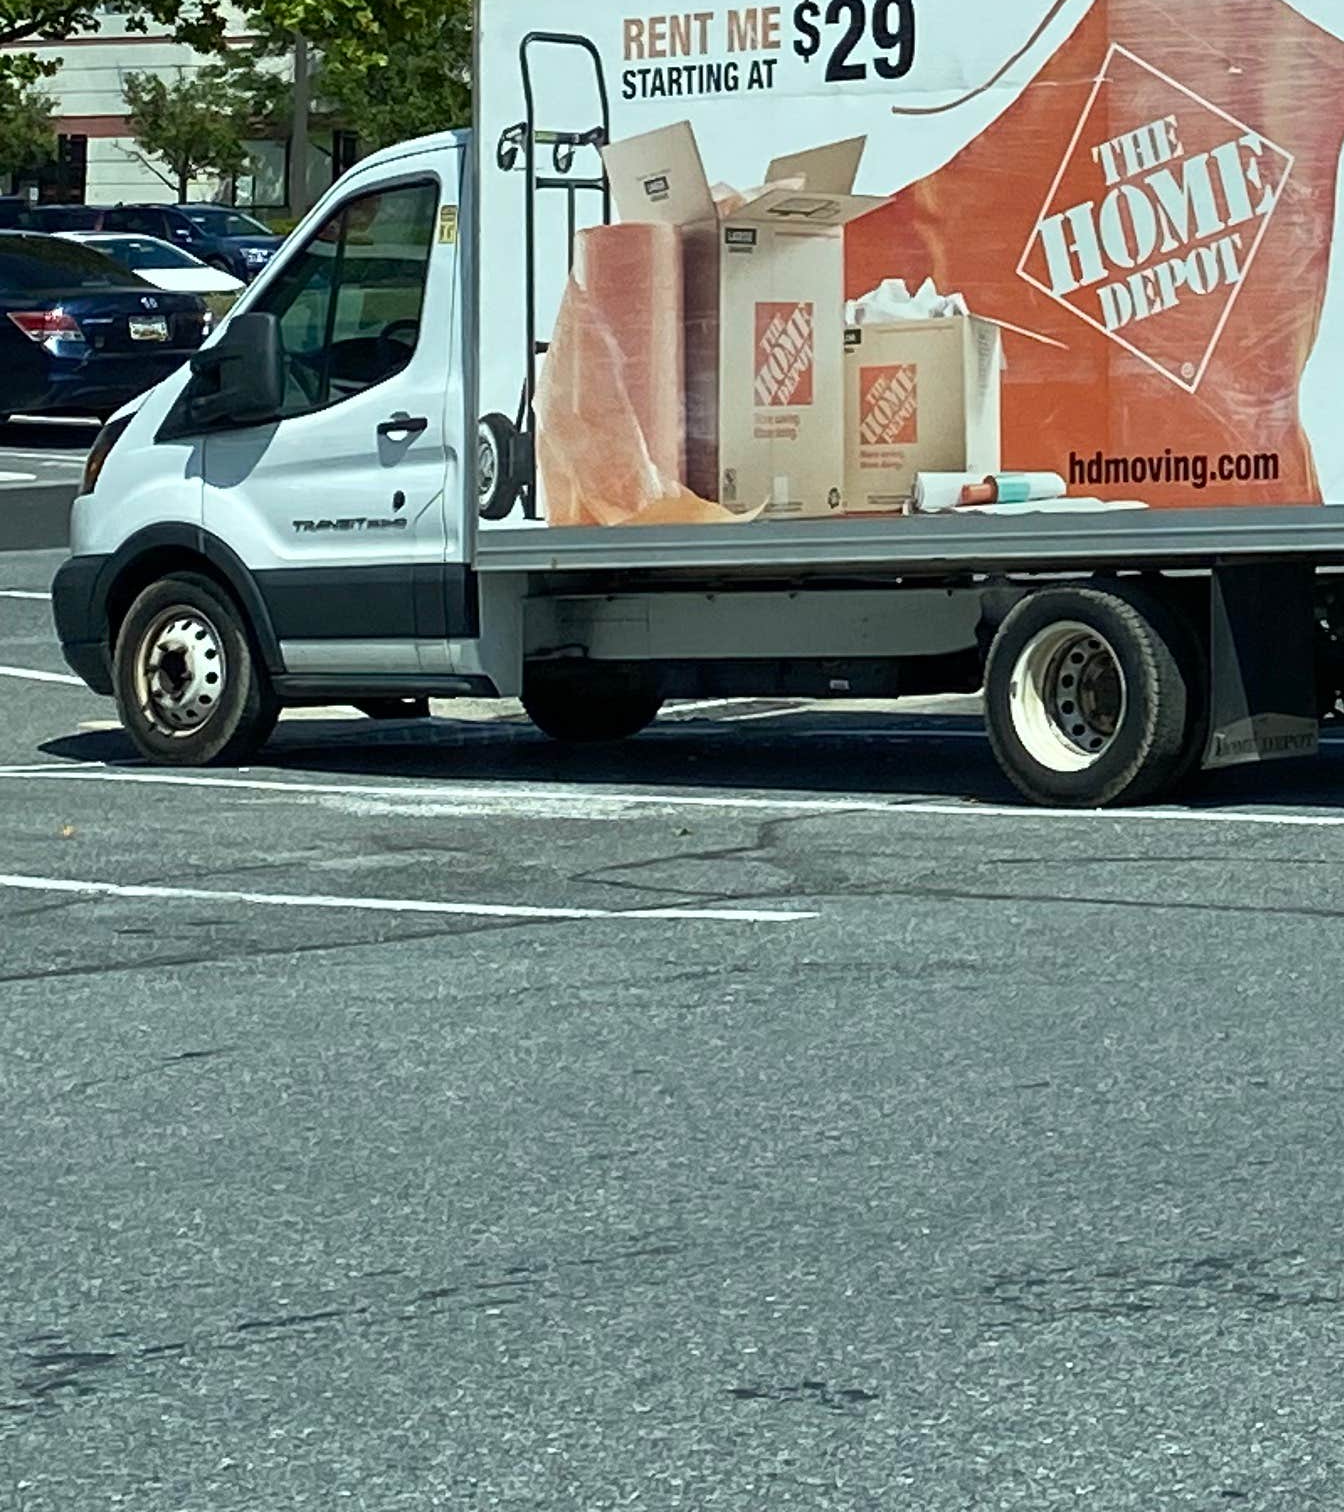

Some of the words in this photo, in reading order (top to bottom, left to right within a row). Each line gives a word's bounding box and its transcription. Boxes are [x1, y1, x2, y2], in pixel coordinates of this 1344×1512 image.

[623, 12, 714, 61] RENT
[727, 6, 781, 53] ME
[622, 62, 739, 100] STARTING
[747, 59, 777, 90] AT
[1091, 115, 1183, 186] THE
[1037, 133, 1276, 297] HOME
[1096, 233, 1243, 332] DEPOT
[754, 303, 813, 406] HOME
[760, 312, 787, 354] THE
[776, 341, 813, 406] DEPOT
[860, 364, 917, 445] HOME
[881, 395, 917, 445] DEPOT
[1069, 448, 1279, 489] hdmoving.com
